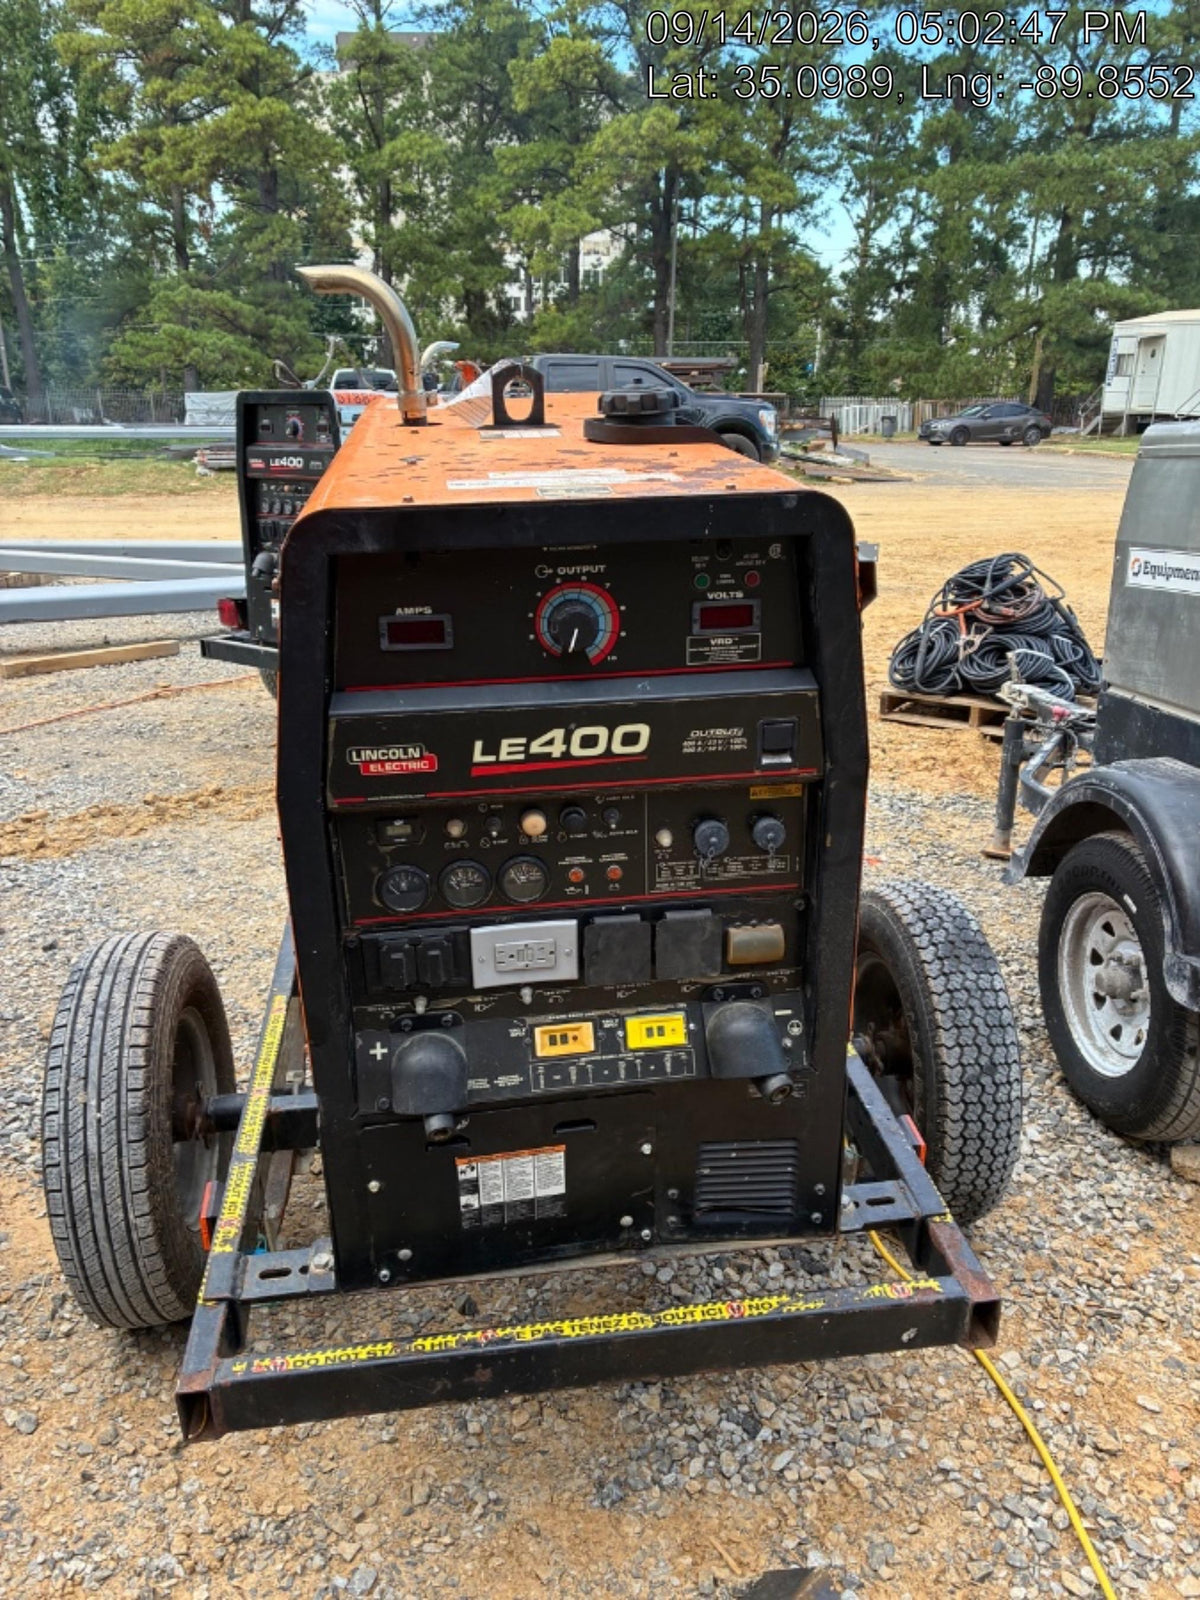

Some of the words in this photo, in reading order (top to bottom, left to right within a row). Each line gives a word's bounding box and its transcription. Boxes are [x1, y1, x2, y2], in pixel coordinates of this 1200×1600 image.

[556, 564, 607, 575] OUTPUT
[706, 590, 744, 600] VOLTS
[395, 606, 432, 616] AMPS
[472, 723, 651, 764] LE400
[351, 747, 421, 762] LINCOLN
[369, 759, 429, 772] ELECTRIC
[749, 1302, 773, 1311] NO
[571, 1318, 625, 1333] TENEZ
[701, 1307, 723, 1318] ICI
[293, 1357, 319, 1368] DO
[325, 1351, 360, 1364] NOT
